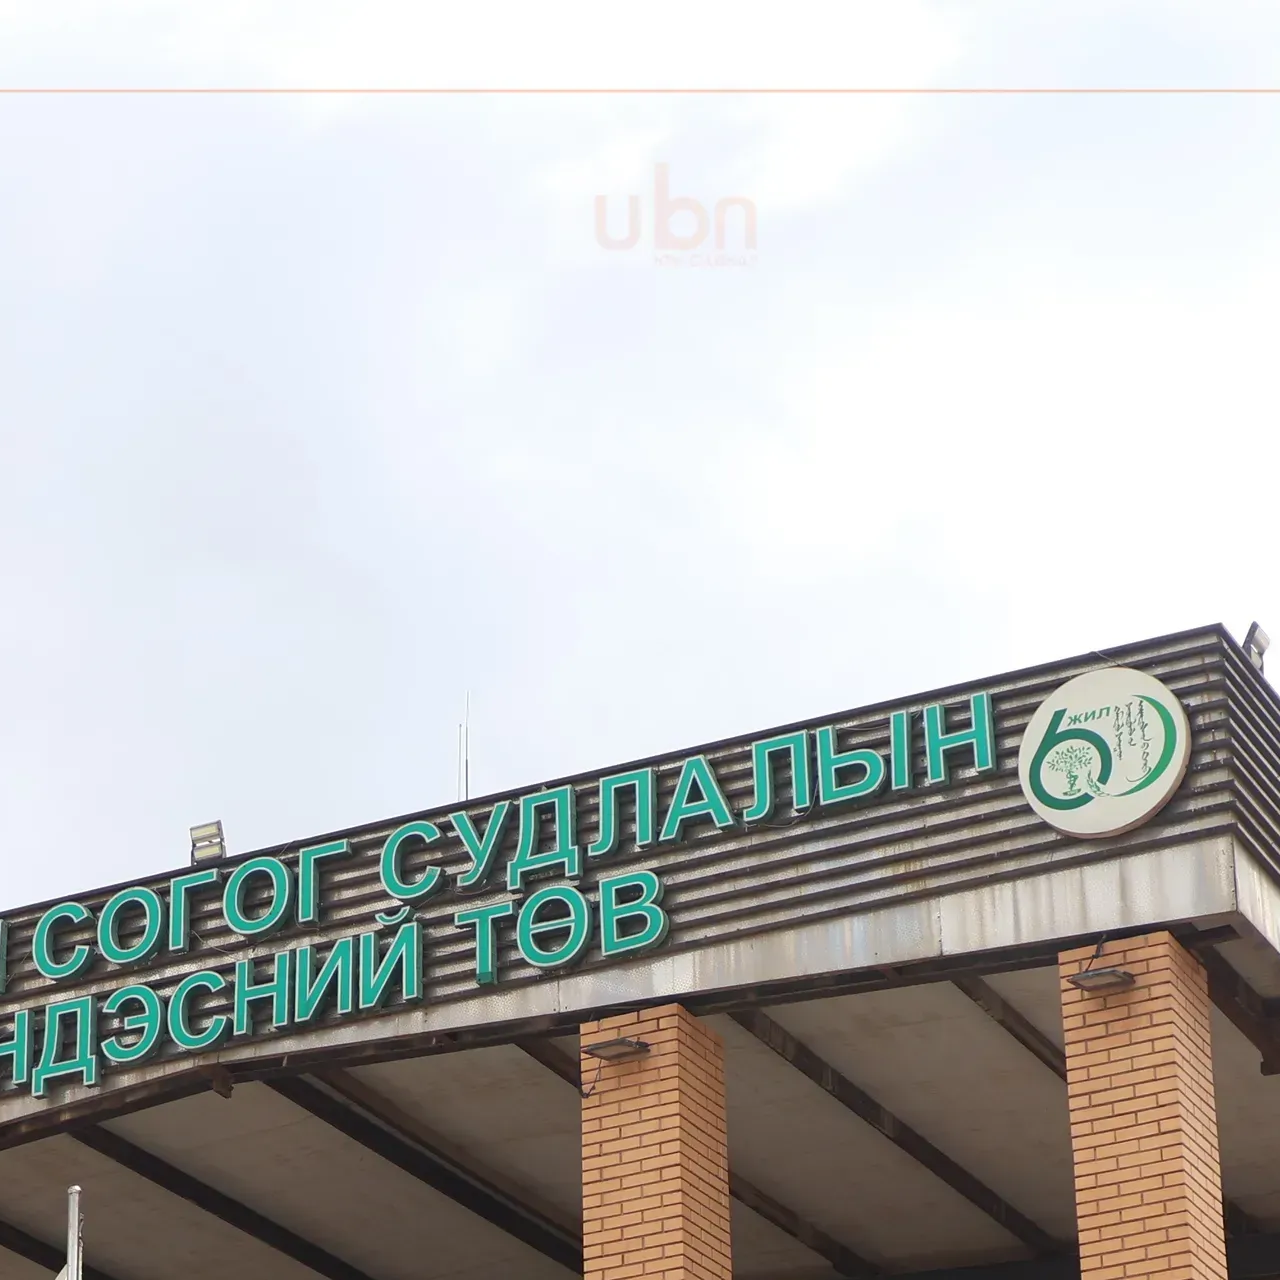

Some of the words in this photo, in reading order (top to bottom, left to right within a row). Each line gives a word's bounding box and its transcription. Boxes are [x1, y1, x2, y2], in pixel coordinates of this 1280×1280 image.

[31, 838, 352, 980] СОГОГ
[379, 690, 996, 901] СУДЛАЛЫН
[454, 868, 670, 986] ТӨВ
